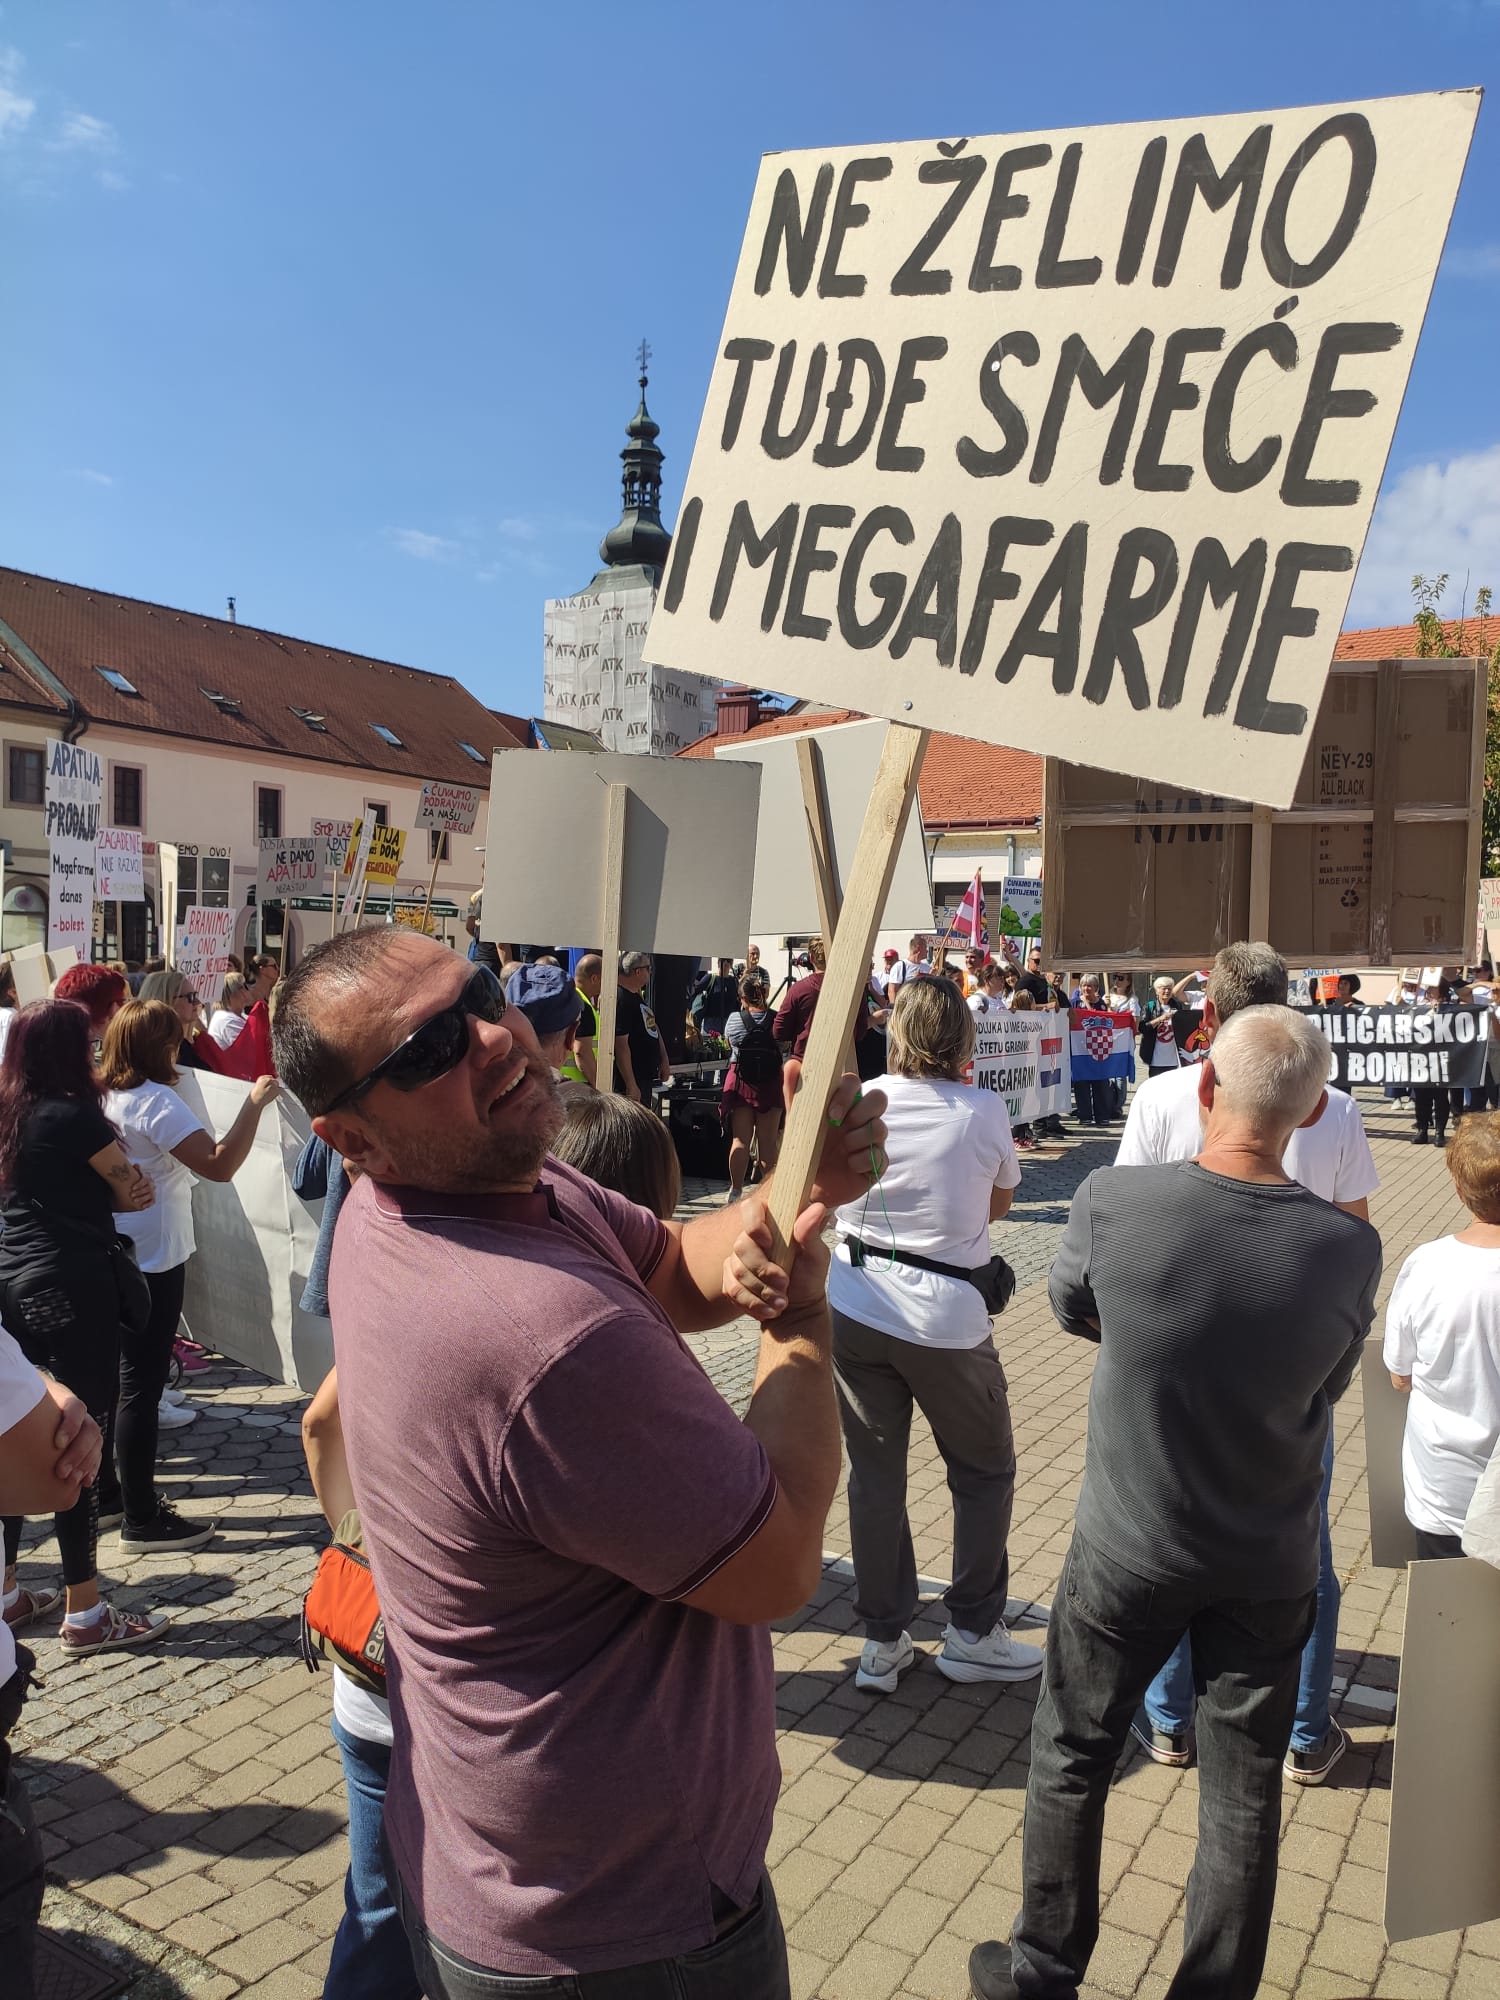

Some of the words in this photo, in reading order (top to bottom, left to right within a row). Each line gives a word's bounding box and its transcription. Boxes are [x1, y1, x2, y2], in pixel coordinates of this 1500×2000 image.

[753, 155, 893, 299] NE
[891, 111, 1378, 297] ŽELIMO
[720, 334, 949, 474] TUĐE
[955, 294, 1406, 508] SMEĆE
[579, 593, 600, 609] ATK
[602, 606, 624, 623] ATK
[662, 496, 704, 616] I
[709, 499, 1356, 737] MEGAFARME
[625, 621, 648, 638] ATK
[556, 643, 577, 659] ATK
[578, 642, 599, 660] ATK
[601, 657, 623, 673] ATK
[625, 671, 647, 687] ATK
[649, 683, 665, 703] ATK
[665, 680, 681, 699] ATK
[556, 692, 577, 708] ATK
[579, 692, 600, 710] ATK
[683, 691, 698, 708] ATK
[601, 707, 624, 722] ATK
[626, 721, 648, 738] ATK
[665, 730, 680, 748] ATK
[50, 742, 100, 787] APATIJA
[1320, 779, 1335, 796] ALL
[1336, 778, 1365, 796] BLACK
[423, 796, 475, 813] PODRAVINU
[422, 808, 435, 818] ZA
[437, 808, 462, 822] NAŠU
[313, 821, 334, 836] STOP
[209, 846, 231, 857] OVO!
[327, 836, 351, 852] APAT
[379, 843, 401, 862] DOM
[275, 850, 287, 865] NE
[289, 849, 315, 864] DAMO
[266, 862, 317, 883] APATIJU
[100, 877, 112, 896] NE
[1318, 877, 1341, 886] MADE
[59, 884, 83, 903] danas
[188, 910, 230, 936] BRANIMO
[197, 937, 217, 955] ONO
[1003, 1021, 1009, 1034] U
[979, 1039, 1004, 1055] ŠTETU
